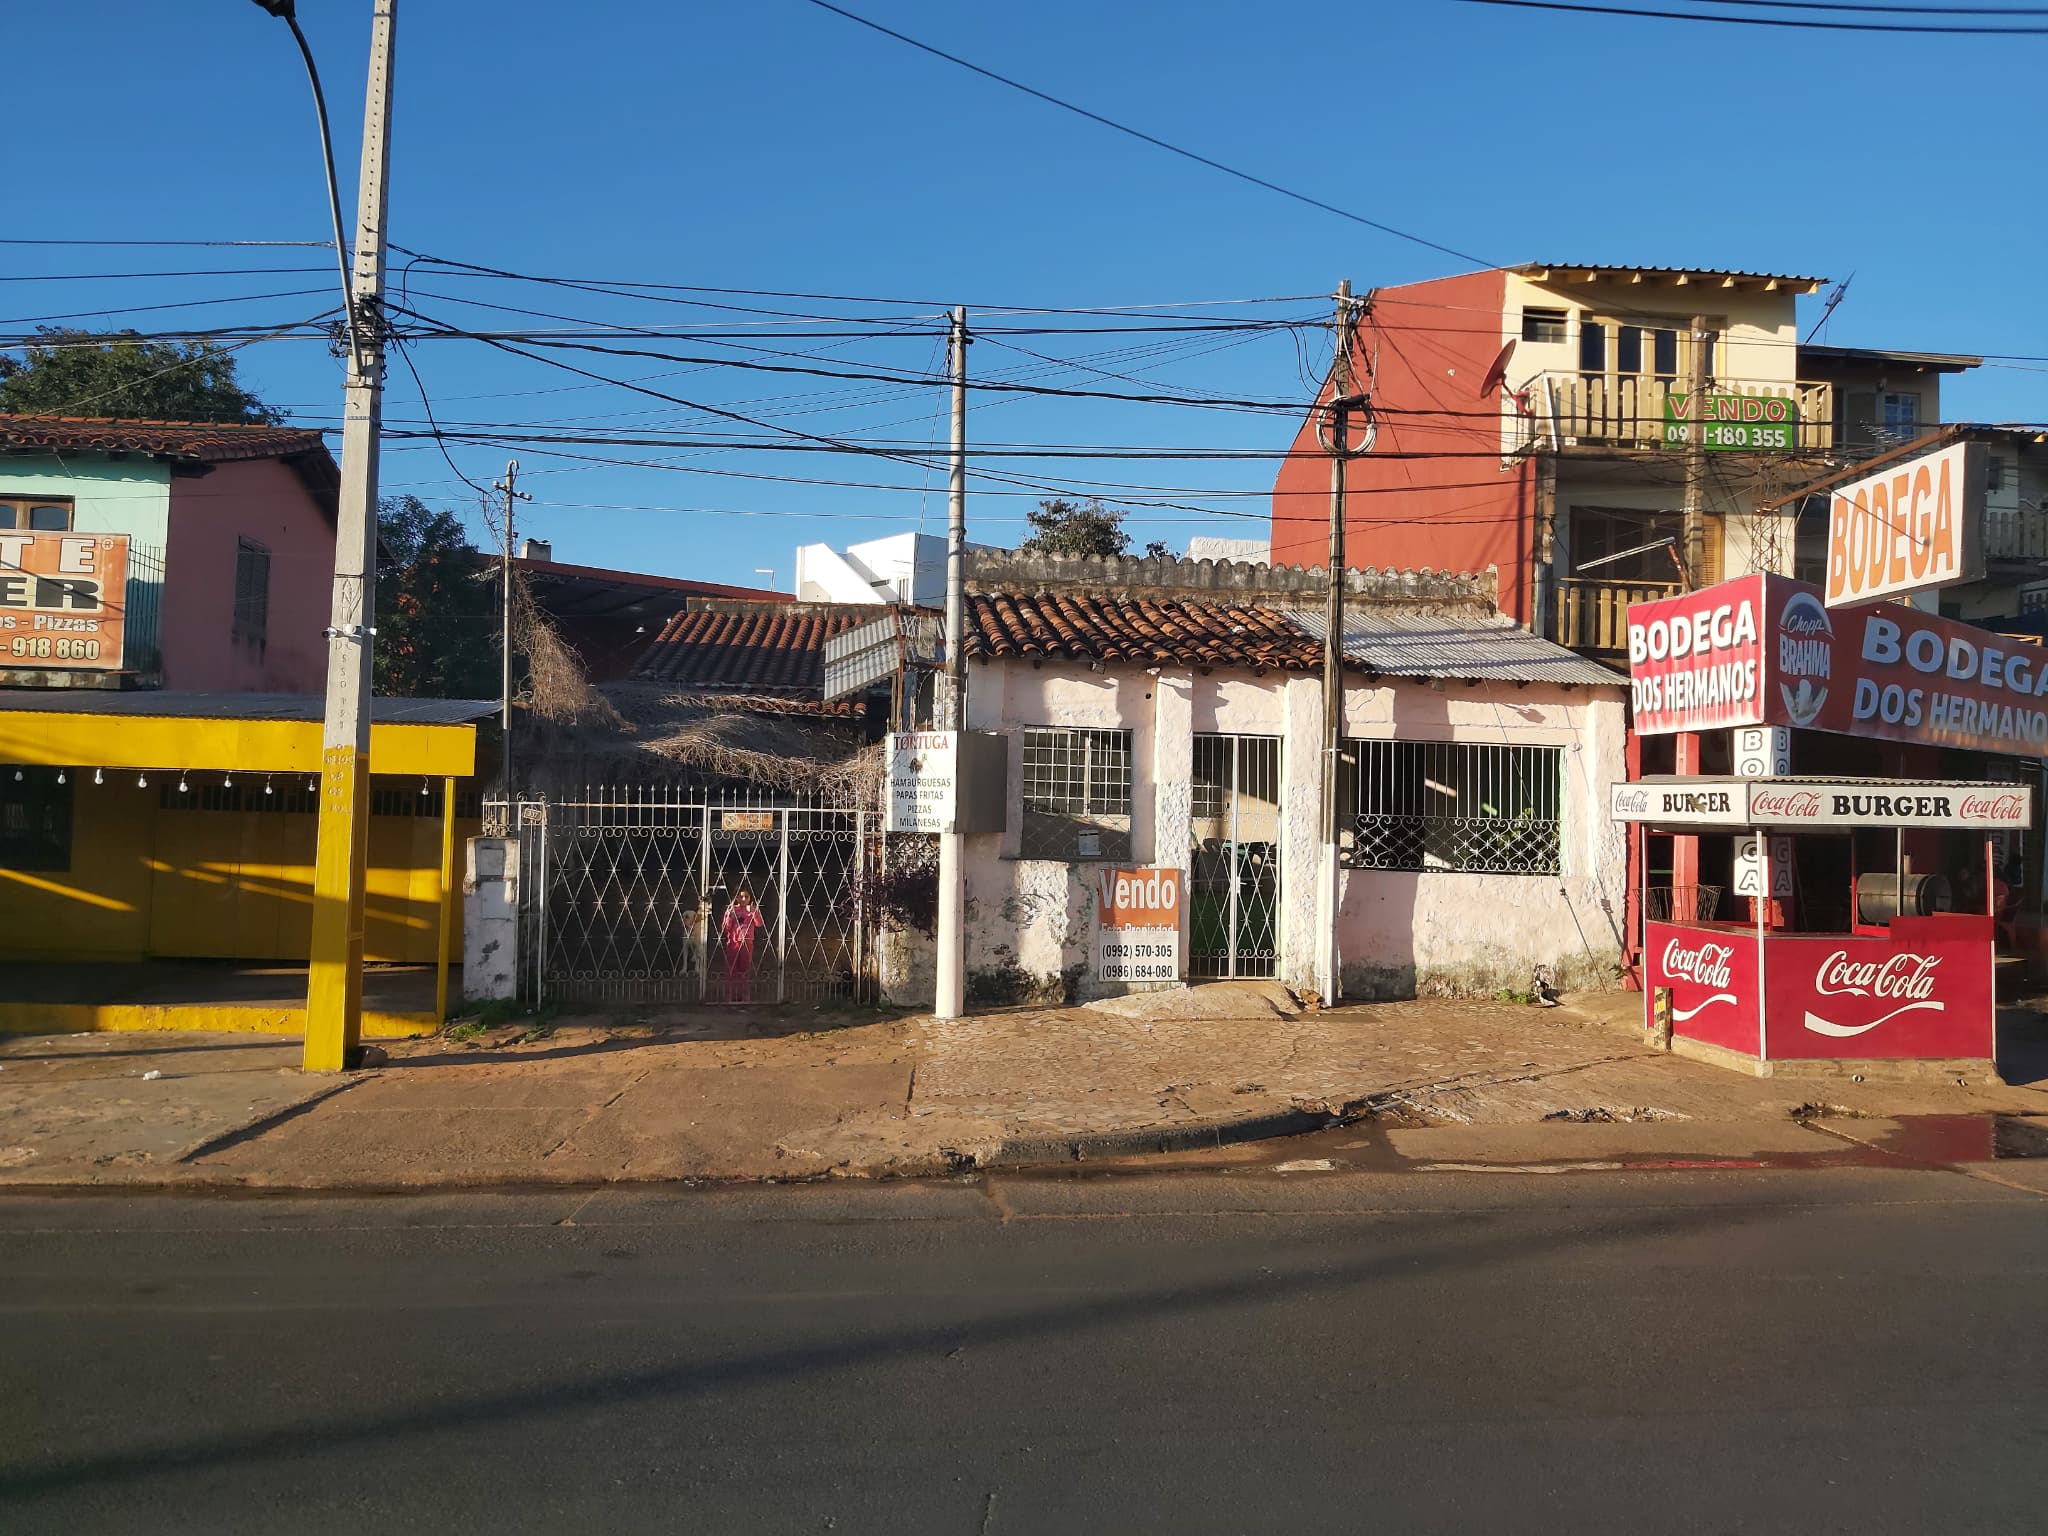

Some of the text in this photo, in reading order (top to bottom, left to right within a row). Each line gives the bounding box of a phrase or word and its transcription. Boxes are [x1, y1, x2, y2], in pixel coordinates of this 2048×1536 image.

[1752, 428, 1786, 448] 355
[1829, 458, 1954, 599] BODEGA
[34, 614, 99, 633] Pizzas
[1629, 600, 1757, 664] BODEGA
[1787, 614, 1825, 637] Chopp
[12, 636, 51, 659] 918
[56, 638, 99, 661] 860
[1779, 632, 1831, 681] BRAHMA
[1632, 658, 1756, 715] DOS HERMANOS
[1853, 678, 1923, 727] DOS
[893, 735, 949, 750] TORTUGA
[890, 778, 951, 787] HAMBURGUESAS
[896, 790, 944, 800] PAPAS FRITAS
[1832, 795, 1952, 818] BURGER
[907, 804, 932, 814] PIZZAS
[899, 818, 941, 827] MILANESAS
[1099, 869, 1176, 910] Vendo
[1102, 945, 1172, 960] (0992) 570-305
[1662, 938, 1735, 989] Coca-Cola
[1102, 965, 1173, 980] (0986) 684-080
[1815, 950, 1943, 1000] Coca-Cola
